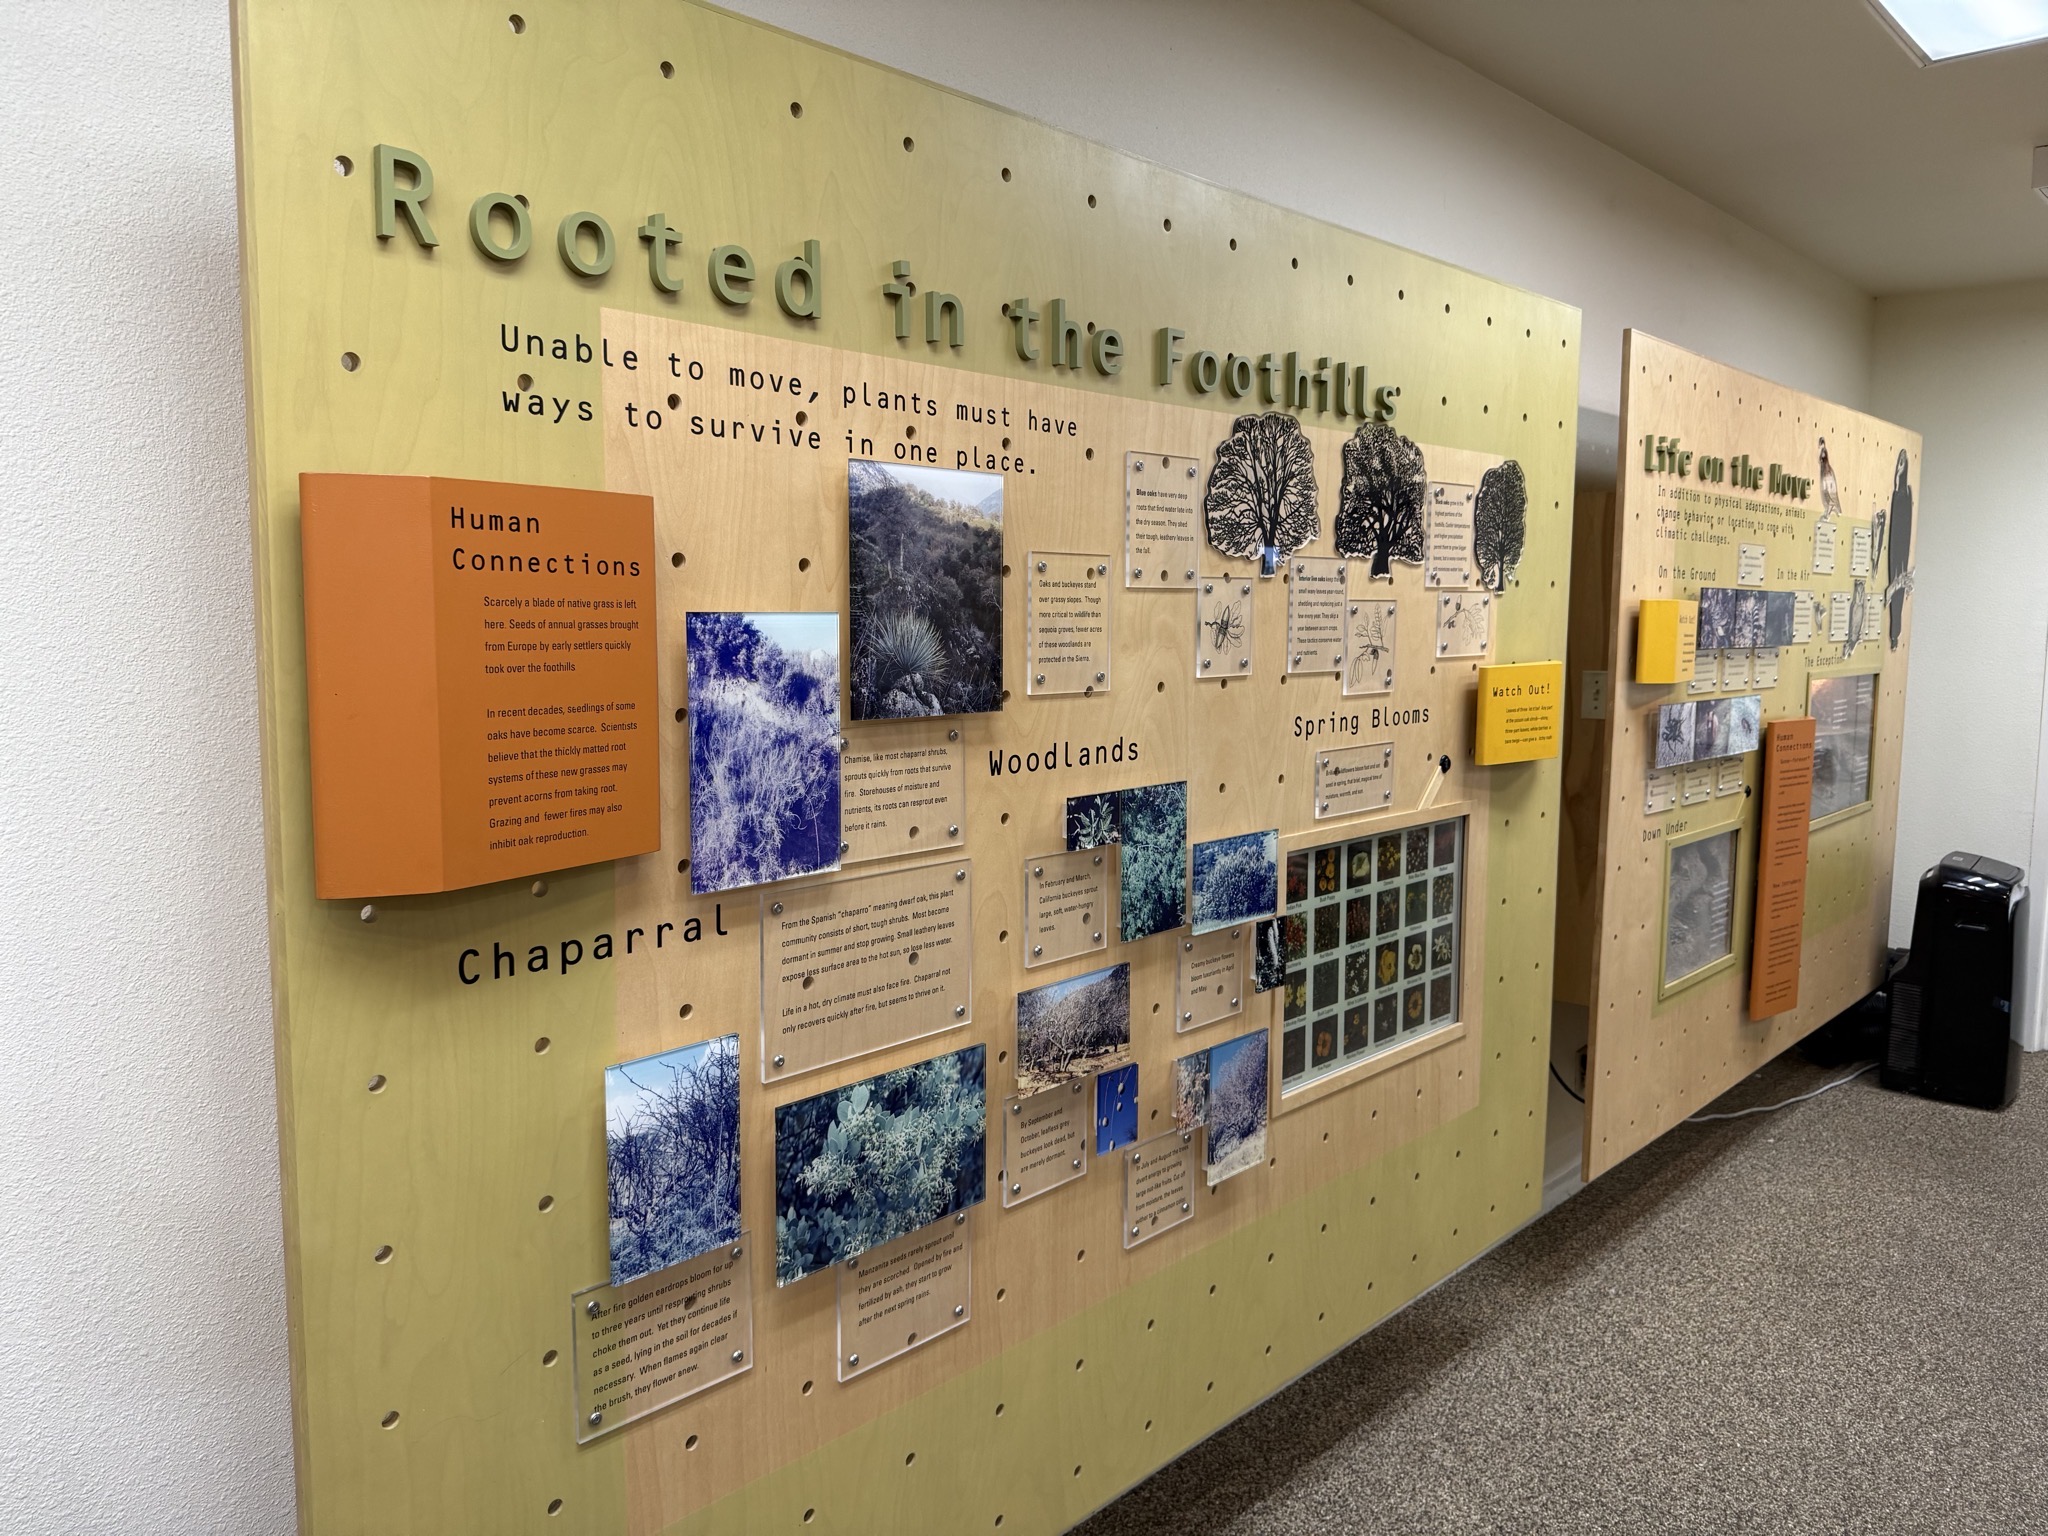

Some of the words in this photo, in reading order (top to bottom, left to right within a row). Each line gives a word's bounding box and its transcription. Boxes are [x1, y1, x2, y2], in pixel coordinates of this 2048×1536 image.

[374, 143, 822, 319] Rooted
[883, 260, 964, 347] in
[1009, 298, 1124, 375] the
[1160, 327, 1398, 421] Foothills
[501, 323, 638, 370] Unable
[668, 353, 704, 380] to
[729, 366, 820, 404] move,
[843, 382, 938, 417] plants
[956, 400, 1010, 428] must
[1028, 408, 1078, 437] have
[502, 391, 593, 423] ways
[625, 403, 662, 430] to
[690, 412, 822, 449] survive
[845, 430, 873, 457] in
[894, 441, 938, 463] one
[956, 445, 1037, 475] place.
[1645, 435, 1691, 476] Life
[1699, 455, 1723, 483] on
[1731, 454, 1763, 490] the
[1769, 463, 1811, 499] Move
[1658, 485, 1666, 496] In
[1670, 487, 1700, 503] addition
[1704, 493, 1711, 504] to
[1715, 494, 1741, 509] physical
[1746, 499, 1782, 515] adaptations,
[1785, 506, 1805, 519] animals
[451, 507, 540, 533] Human
[1657, 507, 1680, 520] change
[1684, 511, 1713, 523] behavior
[1717, 515, 1724, 525] or
[1728, 517, 1754, 529] location
[1758, 520, 1764, 531] to
[1767, 524, 1779, 534] cope
[1781, 523, 1793, 534] with
[1656, 528, 1687, 541] climatic
[1691, 531, 1730, 545] challenges.
[453, 548, 640, 576] Connections
[1659, 566, 1667, 579] On
[1673, 567, 1685, 579] the
[1690, 568, 1716, 581] Ground
[1777, 568, 1783, 579] In
[1786, 570, 1797, 580] the
[1800, 571, 1809, 581] Air
[1062, 581, 1083, 589] buckeyes
[484, 596, 523, 609] Scarcely
[532, 598, 555, 608] blade
[557, 598, 565, 608] of
[567, 599, 591, 608] native
[593, 601, 614, 610] grass
[616, 600, 623, 608] is
[624, 599, 637, 609] left
[1084, 595, 1101, 604] Though
[509, 619, 536, 629] Seeds
[538, 619, 546, 629] of
[548, 620, 576, 629] annual
[577, 621, 608, 631] grasses
[610, 620, 639, 631] brought
[485, 641, 505, 651] from
[507, 641, 537, 652] Europe
[540, 641, 550, 652] by
[552, 641, 572, 652] early
[573, 641, 603, 650] settlers
[604, 641, 631, 651] quickly
[485, 664, 504, 674] took
[506, 665, 526, 673] over
[527, 663, 541, 672] the
[1493, 685, 1521, 697] Watch
[1529, 683, 1550, 695] Out!
[487, 709, 495, 718] In
[498, 708, 526, 717] recent
[528, 705, 565, 716] decades,
[567, 703, 605, 713] seedlings
[606, 702, 614, 711] of
[616, 703, 636, 711] some
[1294, 711, 1359, 741] Spring
[1372, 706, 1430, 729] Blooms
[844, 756, 872, 764] Chamise,
[900, 750, 927, 759] chaparral
[928, 748, 948, 756] shrubs,
[989, 736, 1139, 777] Woodlands
[844, 773, 867, 782] sprouts
[868, 770, 889, 780] quickly
[932, 764, 951, 772] survive
[1643, 829, 1661, 842] Down
[1666, 820, 1688, 835] Under
[1044, 879, 1065, 888] February
[1066, 876, 1075, 884] and
[1075, 873, 1091, 881] March,
[782, 921, 798, 930] From
[799, 918, 810, 926] the
[811, 913, 836, 925] Spanish
[873, 901, 898, 911] meaning
[898, 896, 915, 906] dwarf
[916, 895, 928, 903] oak,
[940, 890, 954, 899] plant
[458, 904, 728, 984] Chaparral
[858, 1261, 889, 1278] Manzanita
[890, 1253, 907, 1265] seeds
[908, 1246, 924, 1257] rarely
[925, 1238, 942, 1250] sprout
[943, 1232, 955, 1242] until
[858, 1294, 884, 1310] fertilized
[892, 1286, 904, 1296] ash,
[905, 1280, 917, 1290] they
[918, 1273, 931, 1284] start
[938, 1264, 952, 1277] grow
[593, 1343, 617, 1358] choke
[618, 1335, 638, 1348] them
[639, 1328, 654, 1339] out.
[657, 1321, 669, 1331] Yet
[670, 1315, 686, 1327] they
[687, 1302, 718, 1319] continue
[720, 1297, 731, 1307] life
[594, 1373, 635, 1395] necessary.
[639, 1361, 662, 1375] When
[663, 1350, 688, 1365] flames
[689, 1341, 709, 1355] again
[710, 1333, 728, 1346] clear
